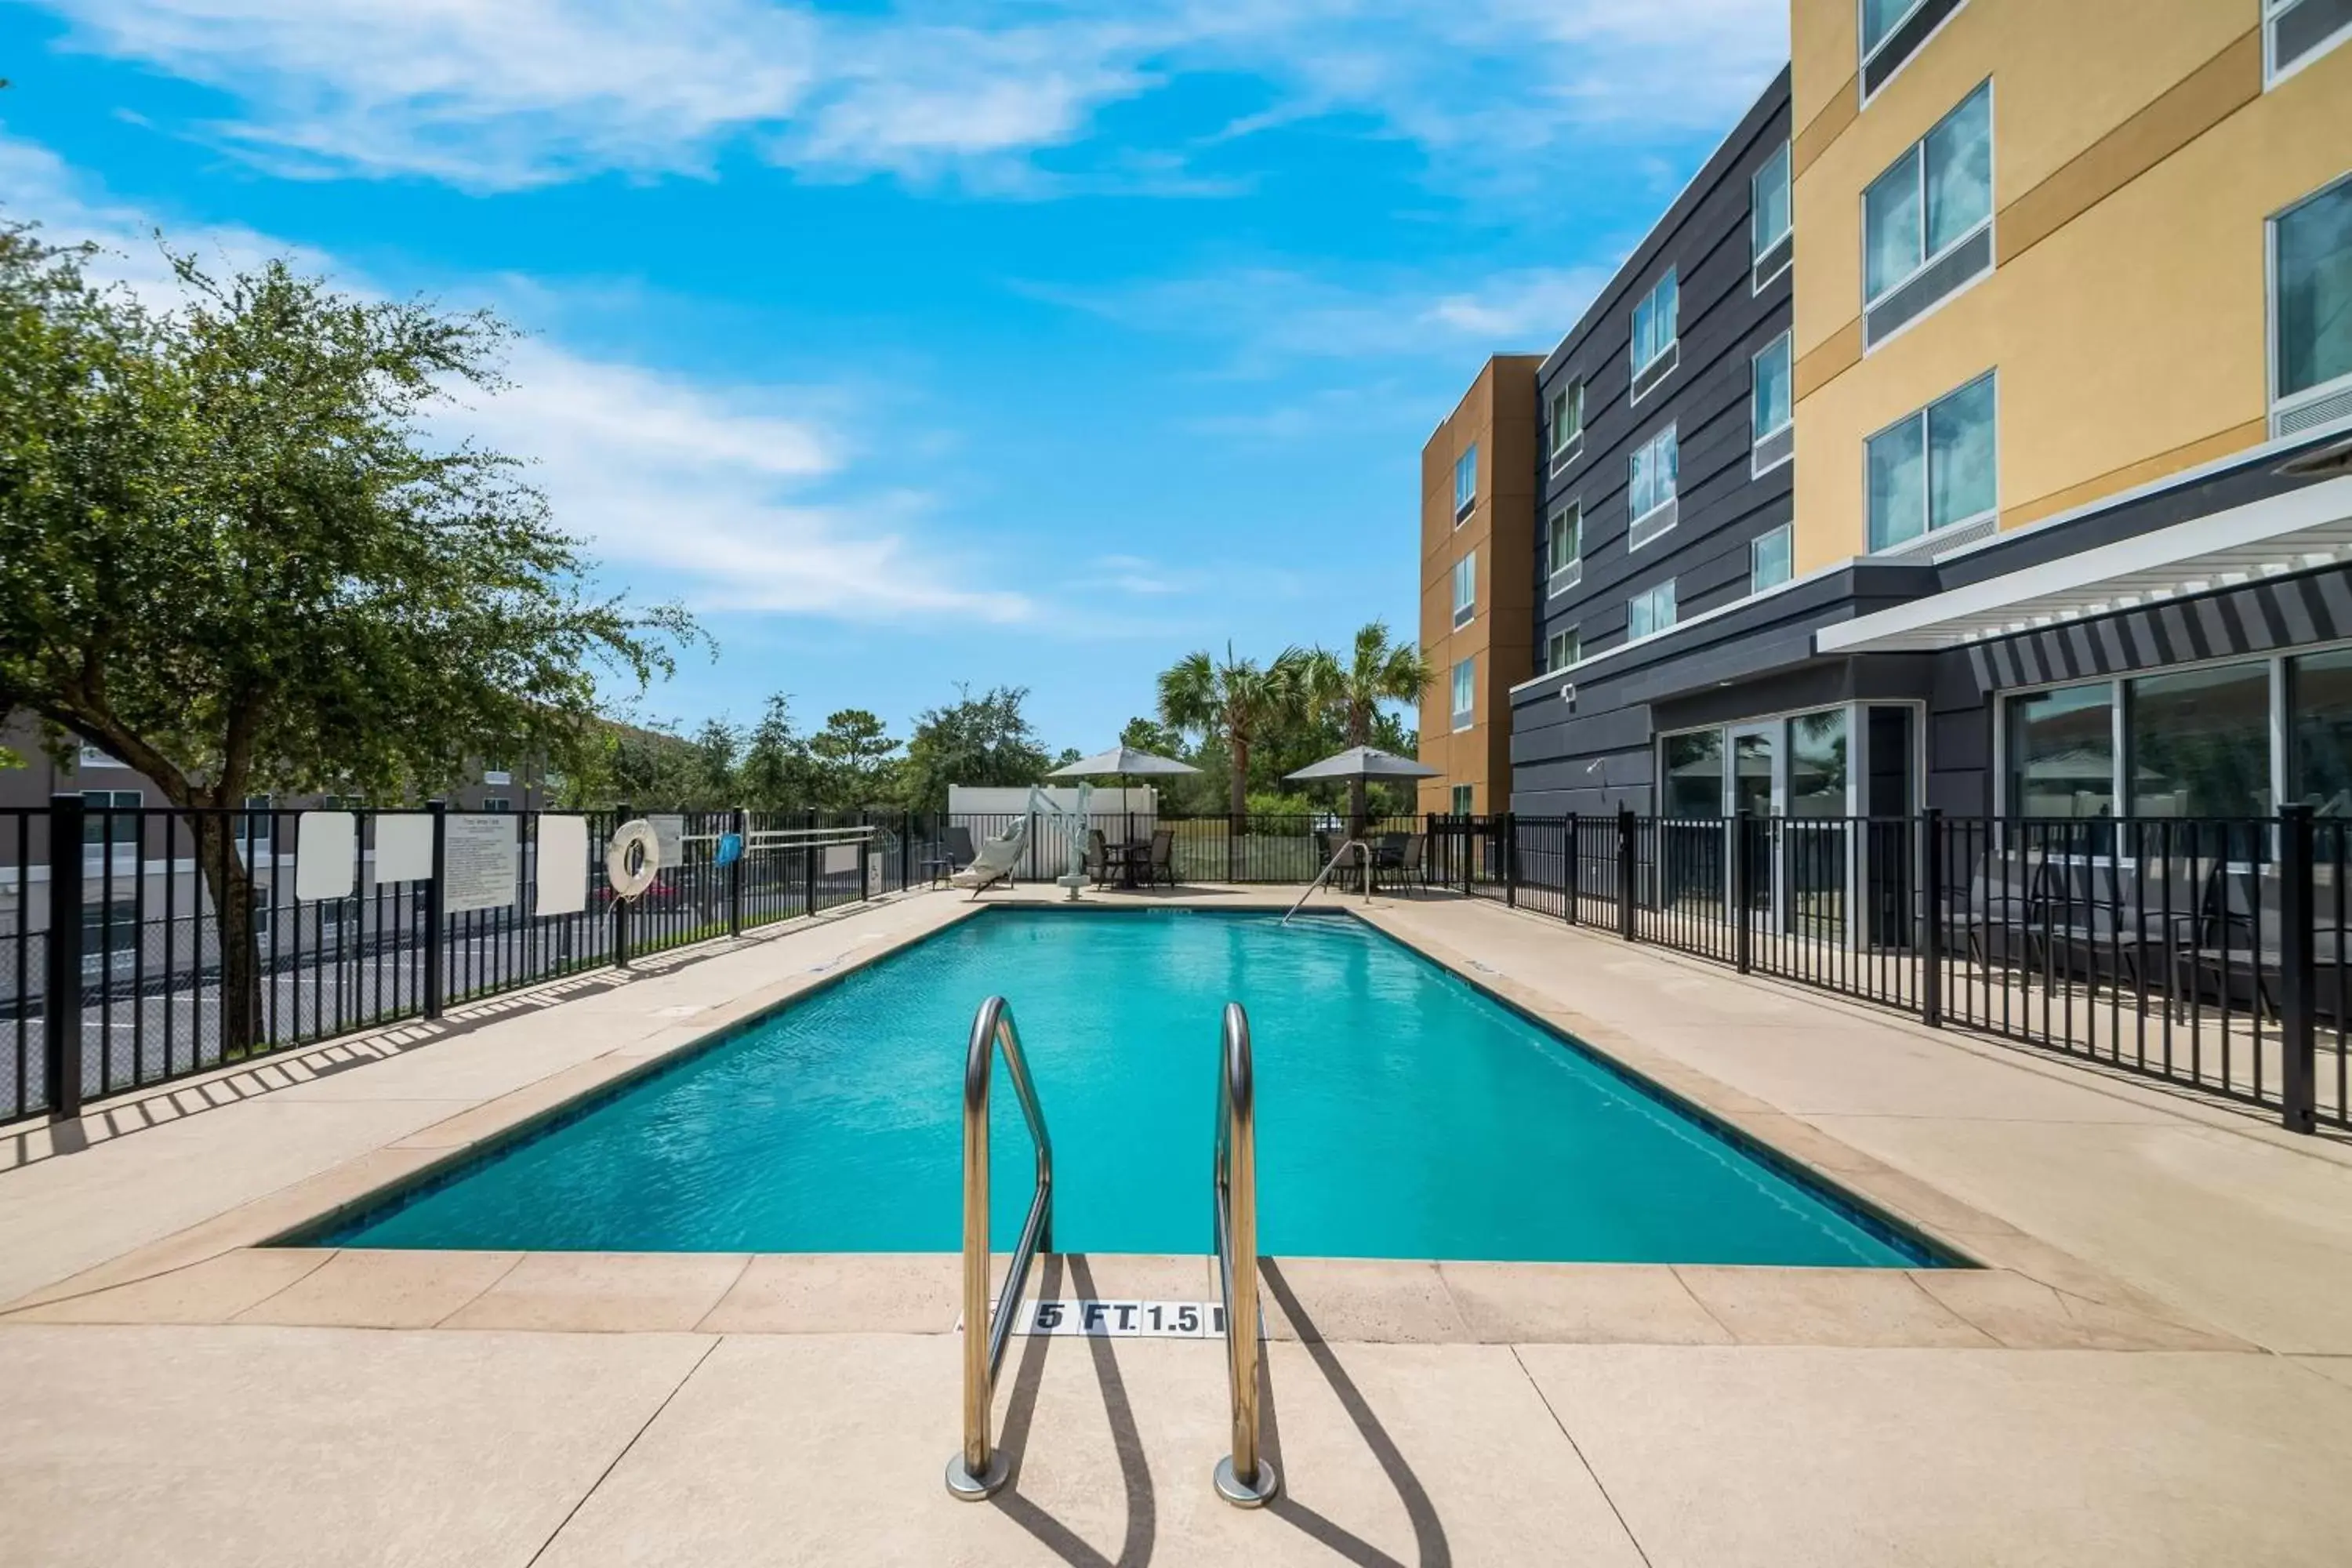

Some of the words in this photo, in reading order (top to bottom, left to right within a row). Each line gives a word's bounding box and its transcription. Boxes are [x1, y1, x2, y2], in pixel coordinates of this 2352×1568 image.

[1037, 1304, 1065, 1329] 5
[1083, 1304, 1137, 1330] FT.
[1148, 1305, 1199, 1331] 1.5
